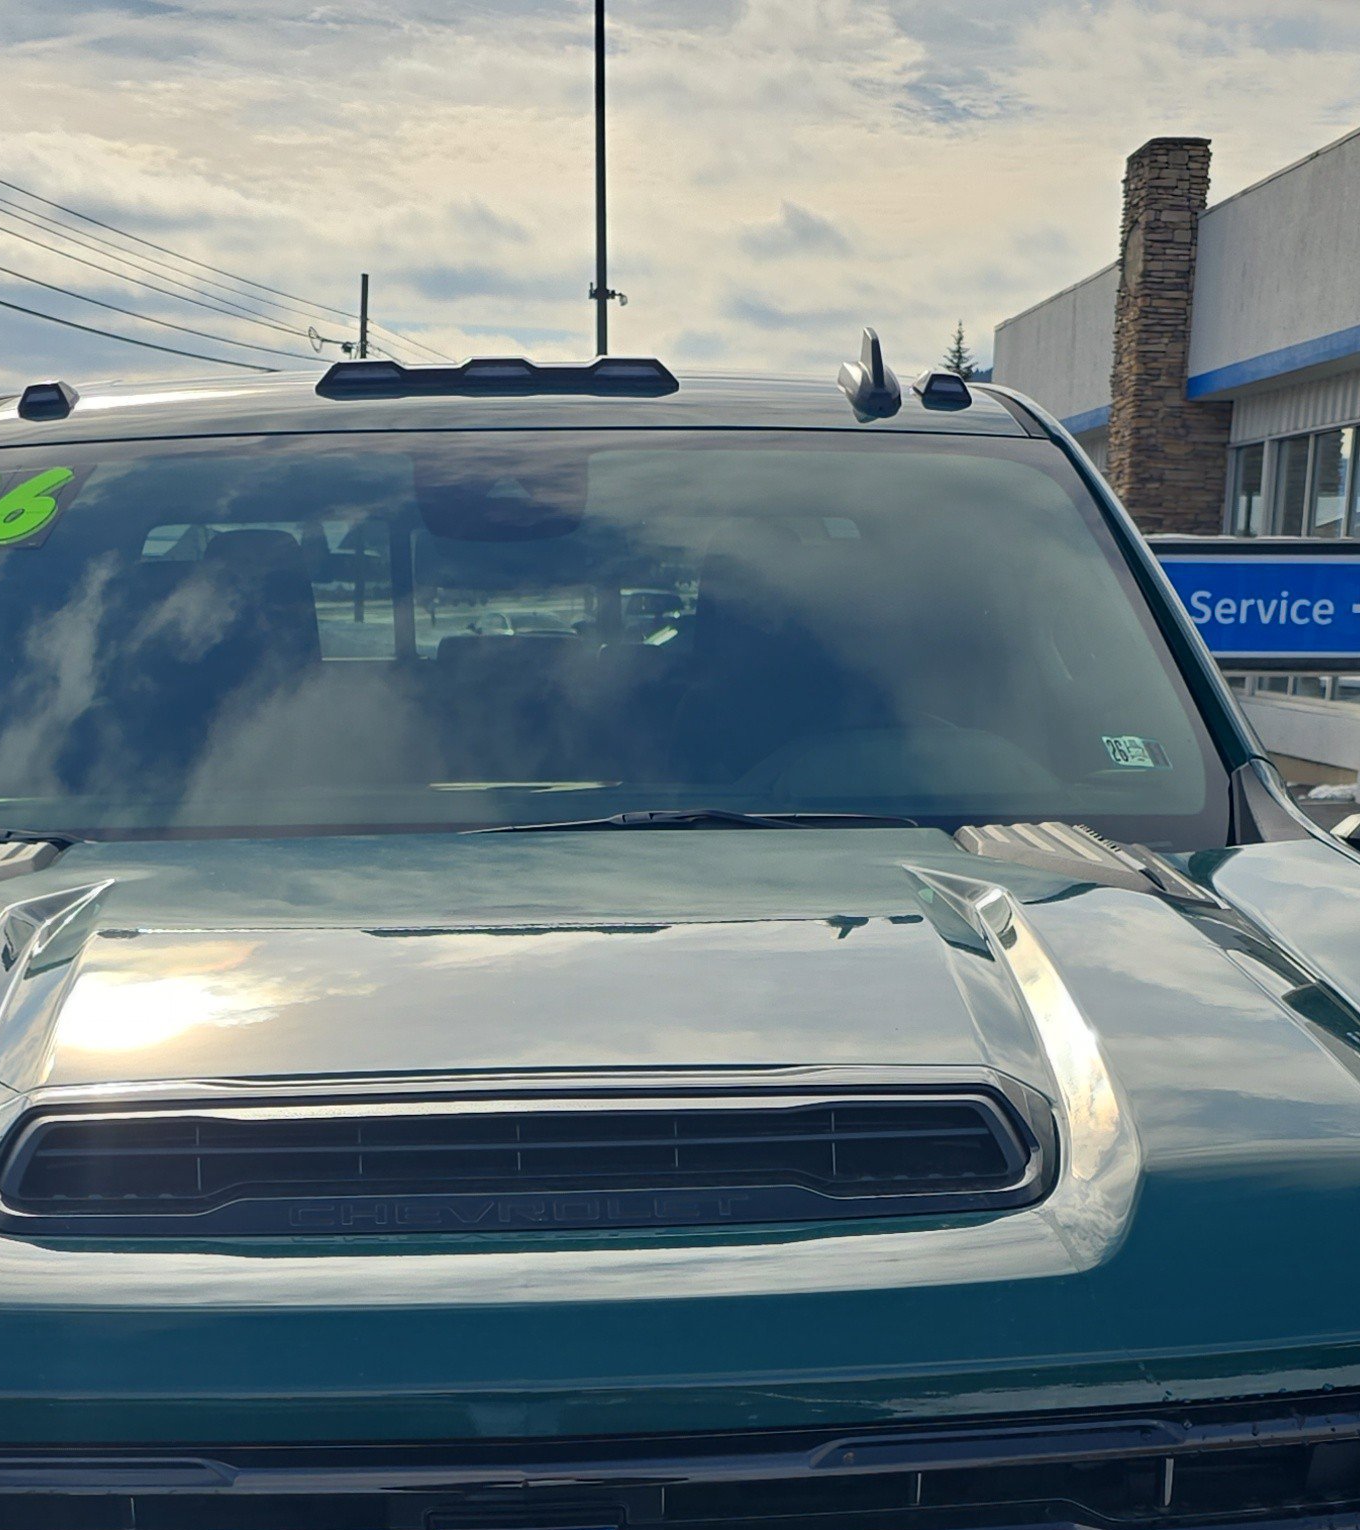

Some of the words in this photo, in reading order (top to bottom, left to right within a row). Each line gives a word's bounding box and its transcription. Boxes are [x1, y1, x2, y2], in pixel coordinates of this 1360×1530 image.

[1190, 590, 1335, 625] Service
[1106, 739, 1129, 762] 26
[288, 1194, 751, 1228] CHEVROLET
